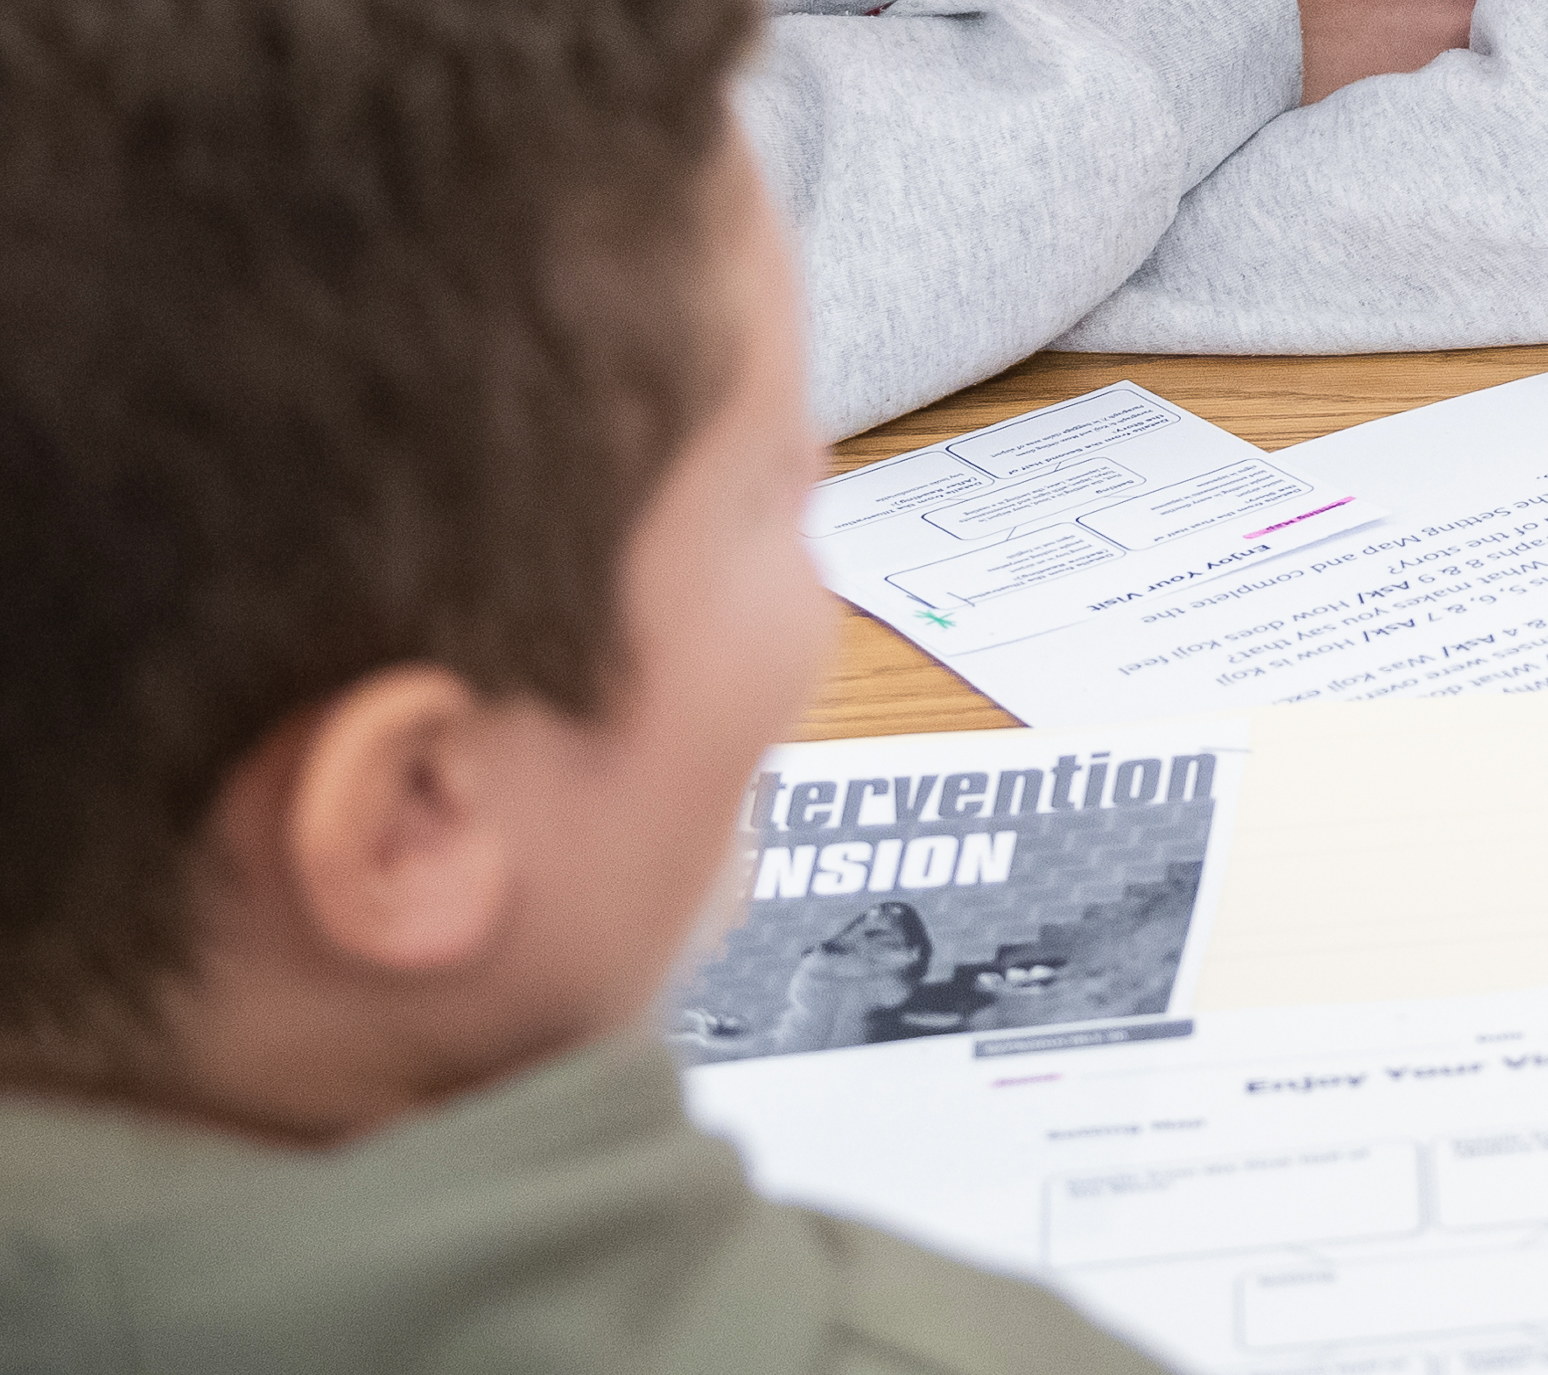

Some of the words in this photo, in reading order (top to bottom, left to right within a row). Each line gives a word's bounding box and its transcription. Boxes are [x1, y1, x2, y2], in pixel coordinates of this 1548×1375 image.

[1420, 506, 1512, 537] Setting
[1512, 521, 1540, 537] of
[1361, 533, 1423, 556] Map
[1465, 531, 1511, 548] the
[1205, 543, 1272, 571] Enjoy
[1308, 552, 1358, 574] and
[1387, 546, 1462, 575] story?
[1463, 557, 1485, 570] 8
[1147, 570, 1203, 593] Your
[1416, 574, 1437, 584] 9
[1438, 564, 1462, 577] &
[1191, 569, 1305, 609] complete
[1355, 579, 1411, 606] Ask/
[1391, 580, 1473, 610] makes
[1469, 593, 1498, 604] 6,
[1498, 585, 1528, 594] 5,
[1087, 591, 1144, 612] Visit
[1291, 599, 1351, 623] How
[1444, 603, 1468, 615] &
[1141, 606, 1186, 624] the
[1340, 605, 1390, 627] you
[1427, 611, 1443, 623] 7
[1524, 618, 1548, 630] &
[1223, 619, 1286, 641] does
[1295, 623, 1338, 642] say
[1361, 616, 1417, 644] Ask/
[1501, 627, 1519, 638] 4
[1170, 639, 1222, 658] Koji
[1226, 637, 1293, 665] that?
[1295, 637, 1356, 661] How
[1440, 632, 1497, 659] Ask/
[1117, 654, 1170, 676] feel
[1268, 657, 1293, 668] is
[1377, 653, 1436, 673] Was
[1426, 656, 1489, 680] were
[1214, 666, 1267, 686] Koji
[1326, 671, 1377, 692] Koji
[1469, 661, 1540, 688] What
[752, 751, 1217, 831] tervention
